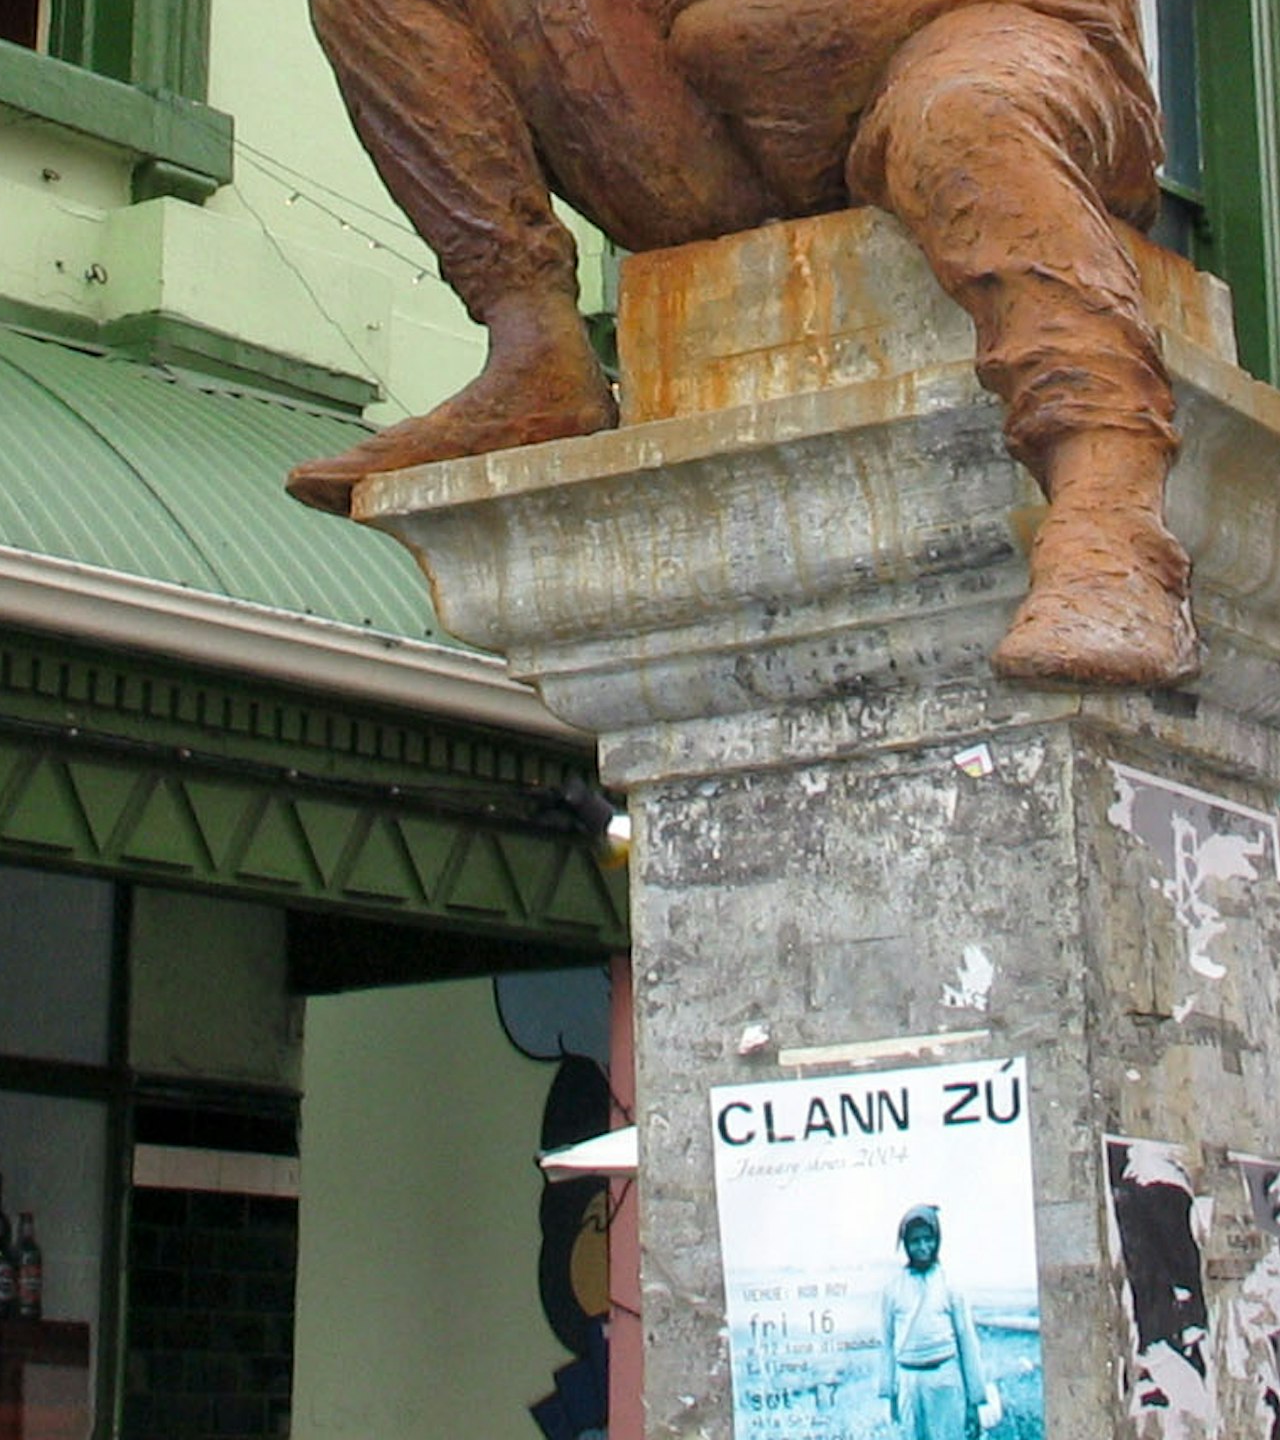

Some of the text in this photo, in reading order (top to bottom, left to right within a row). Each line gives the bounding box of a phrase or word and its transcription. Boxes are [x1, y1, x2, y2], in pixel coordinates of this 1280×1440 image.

[718, 1059, 1021, 1146] CLANN ZÚ
[749, 1308, 835, 1338] fri 16
[808, 1381, 842, 1408] 17
